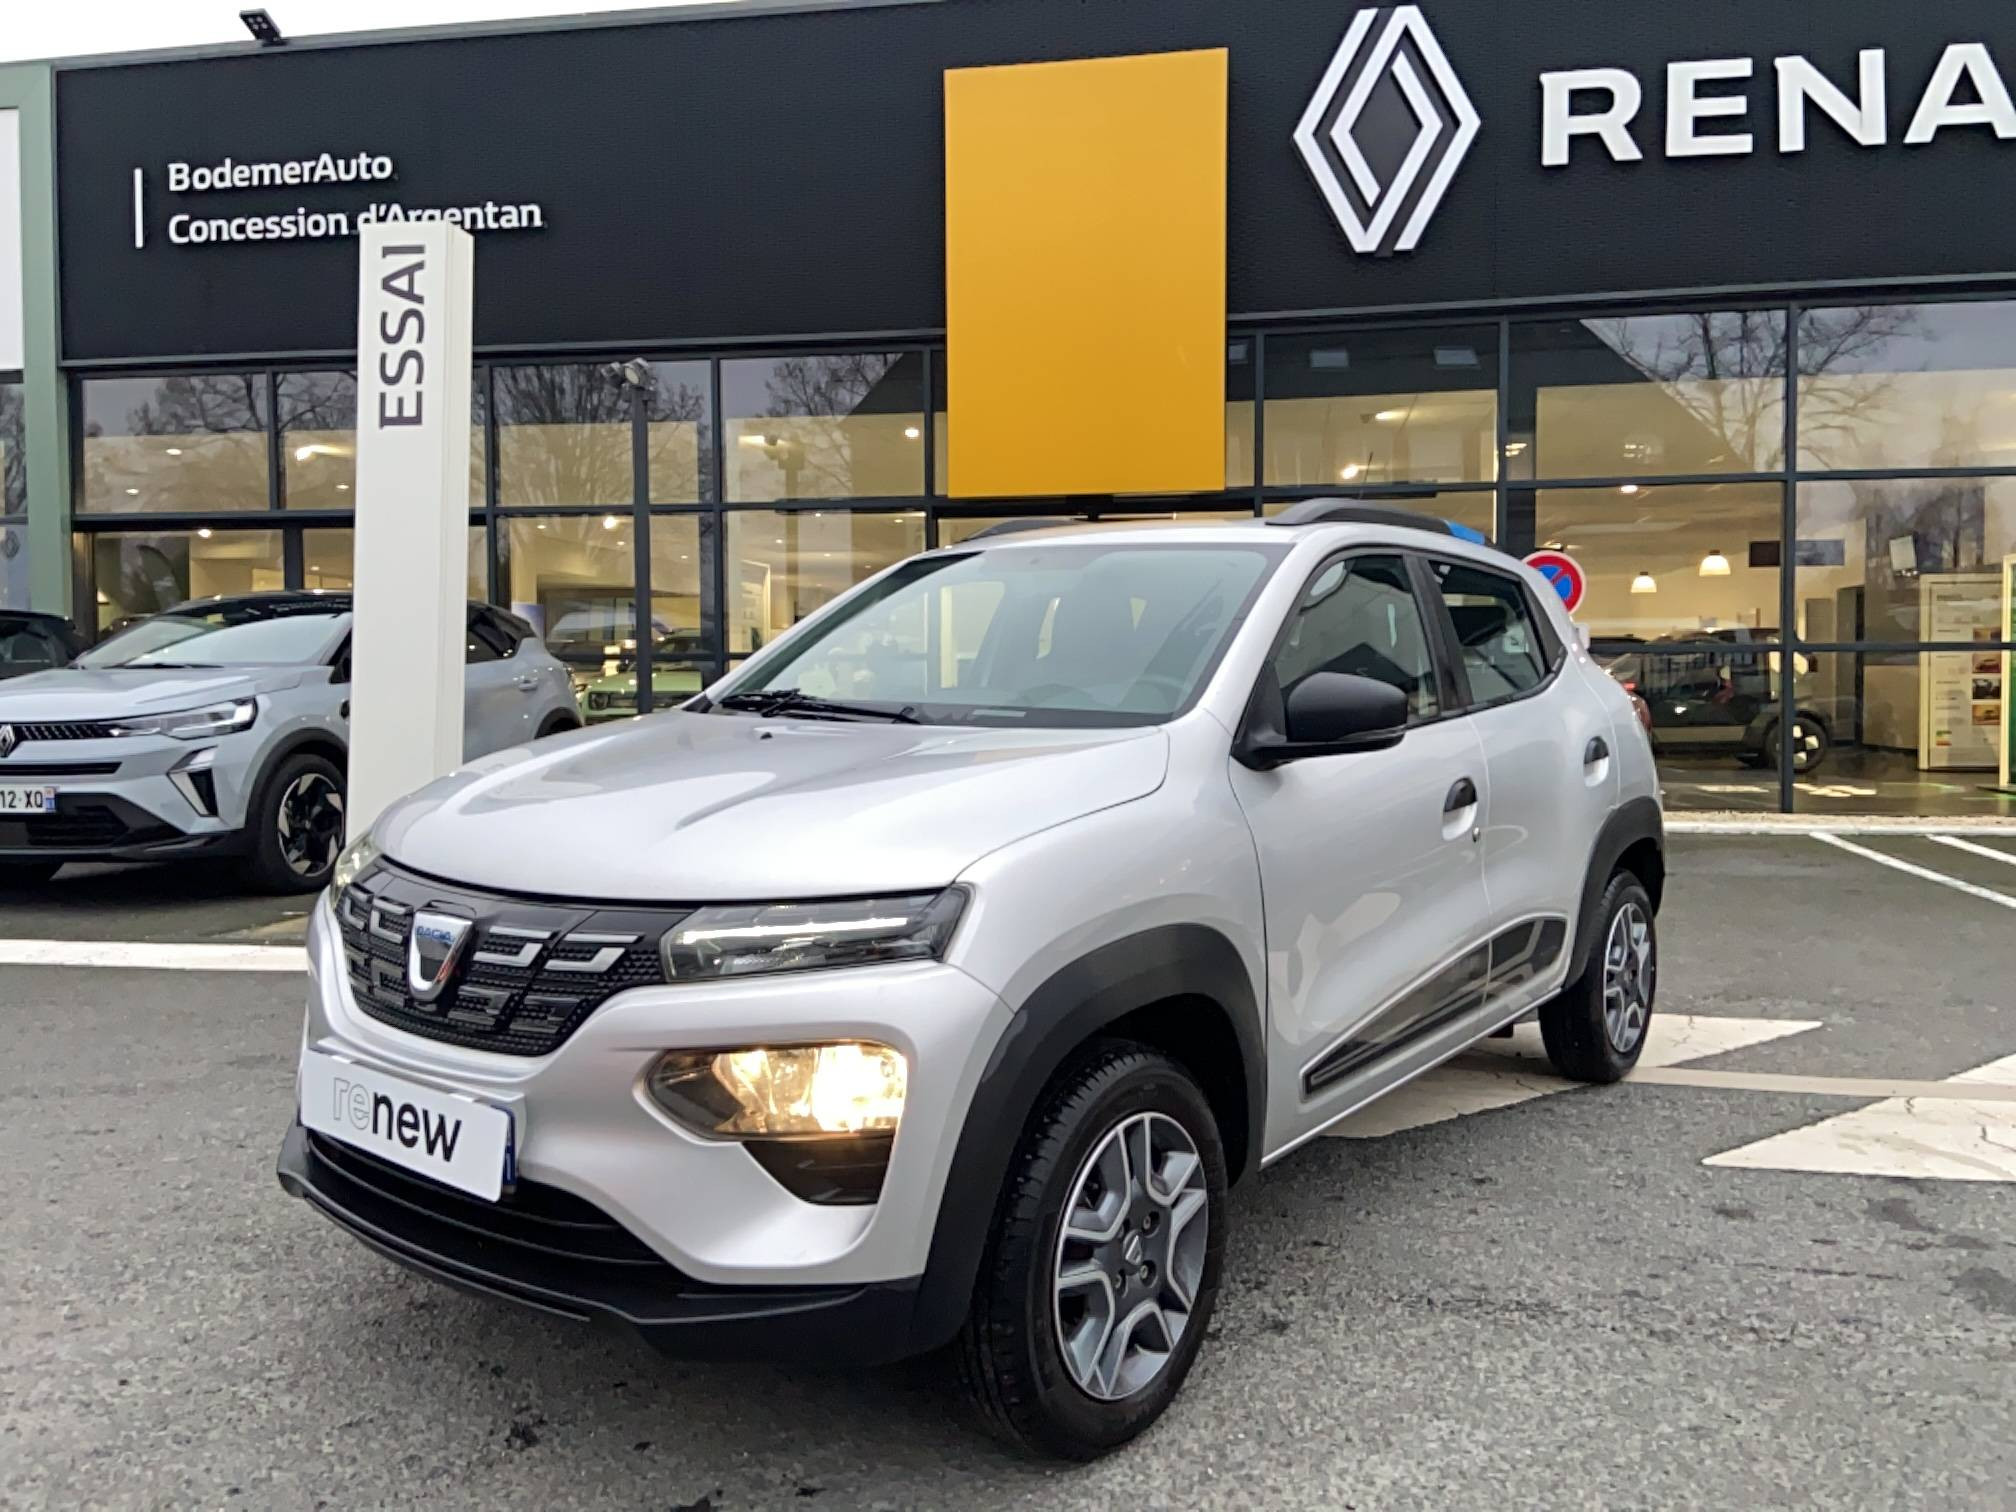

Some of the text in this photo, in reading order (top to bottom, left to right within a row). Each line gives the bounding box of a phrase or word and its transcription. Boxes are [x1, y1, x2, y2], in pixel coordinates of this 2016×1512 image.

[168, 153, 393, 191] BodemerAuto
[168, 207, 349, 244] Concession
[380, 245, 425, 429] ESSAI
[333, 1077, 462, 1162] renew
